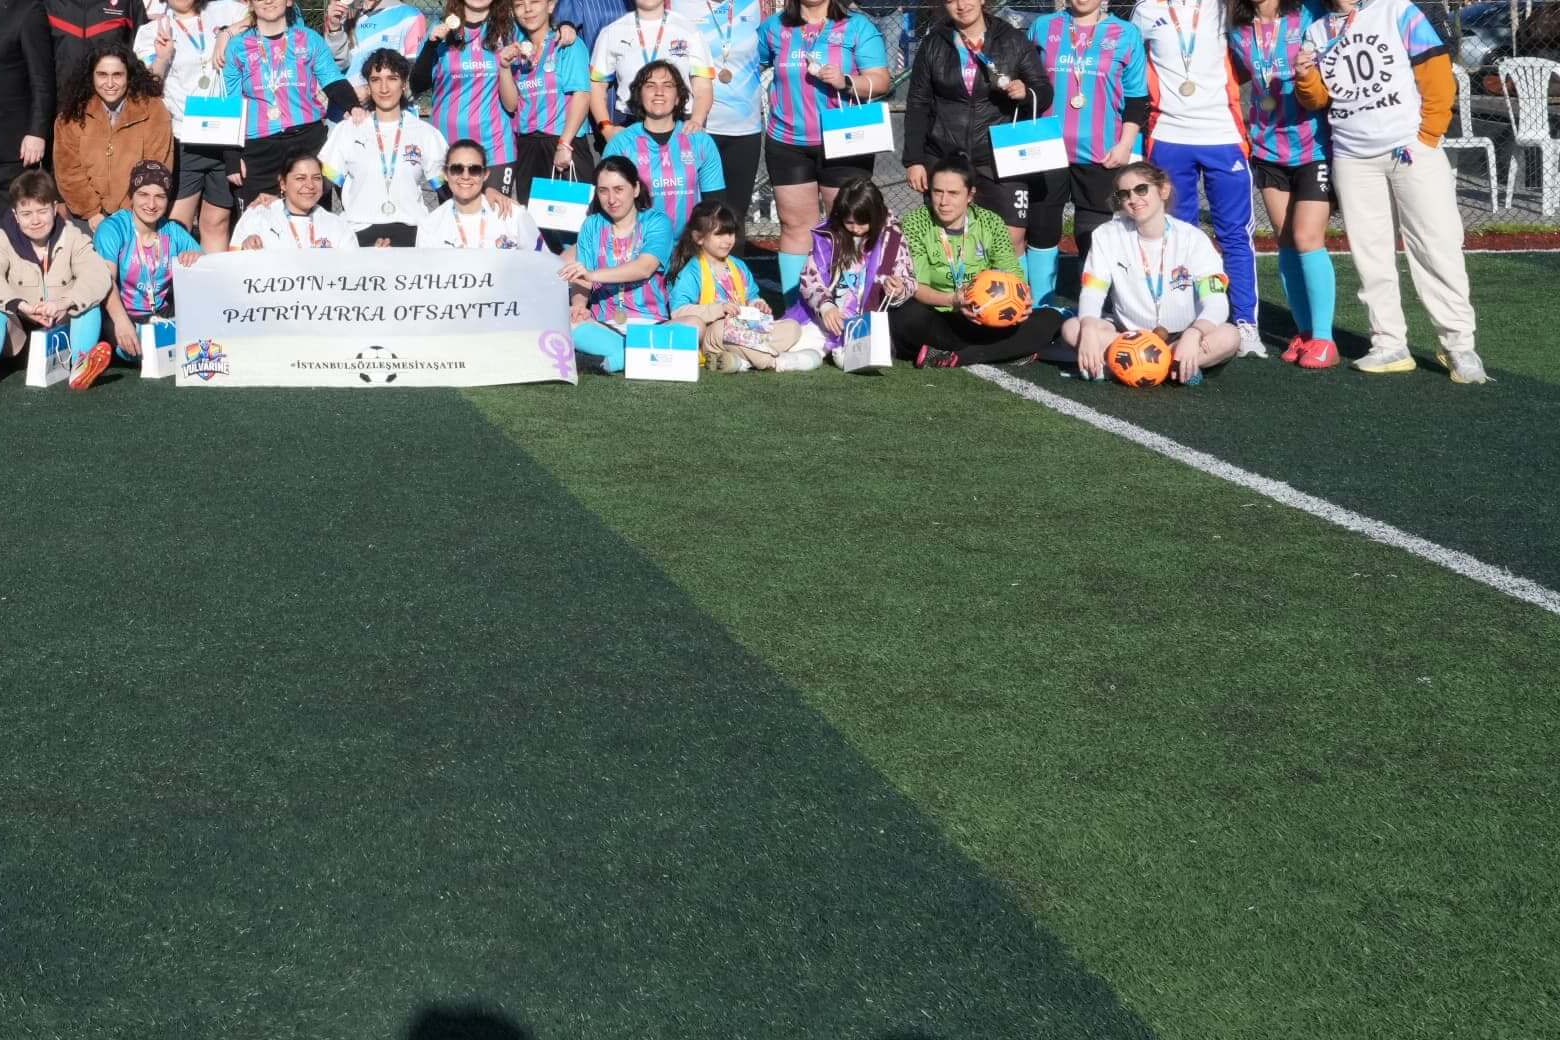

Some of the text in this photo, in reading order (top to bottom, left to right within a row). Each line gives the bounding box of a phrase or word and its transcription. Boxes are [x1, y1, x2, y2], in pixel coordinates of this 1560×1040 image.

[1342, 49, 1375, 85] 10
[1331, 70, 1393, 100] united
[503, 167, 513, 185] 8
[652, 176, 684, 189] GİRNE
[243, 272, 495, 294] KADIN+LAR SAHADA
[945, 271, 977, 281] GNE
[222, 301, 521, 323] PATRİYARKA OFSAYTTA
